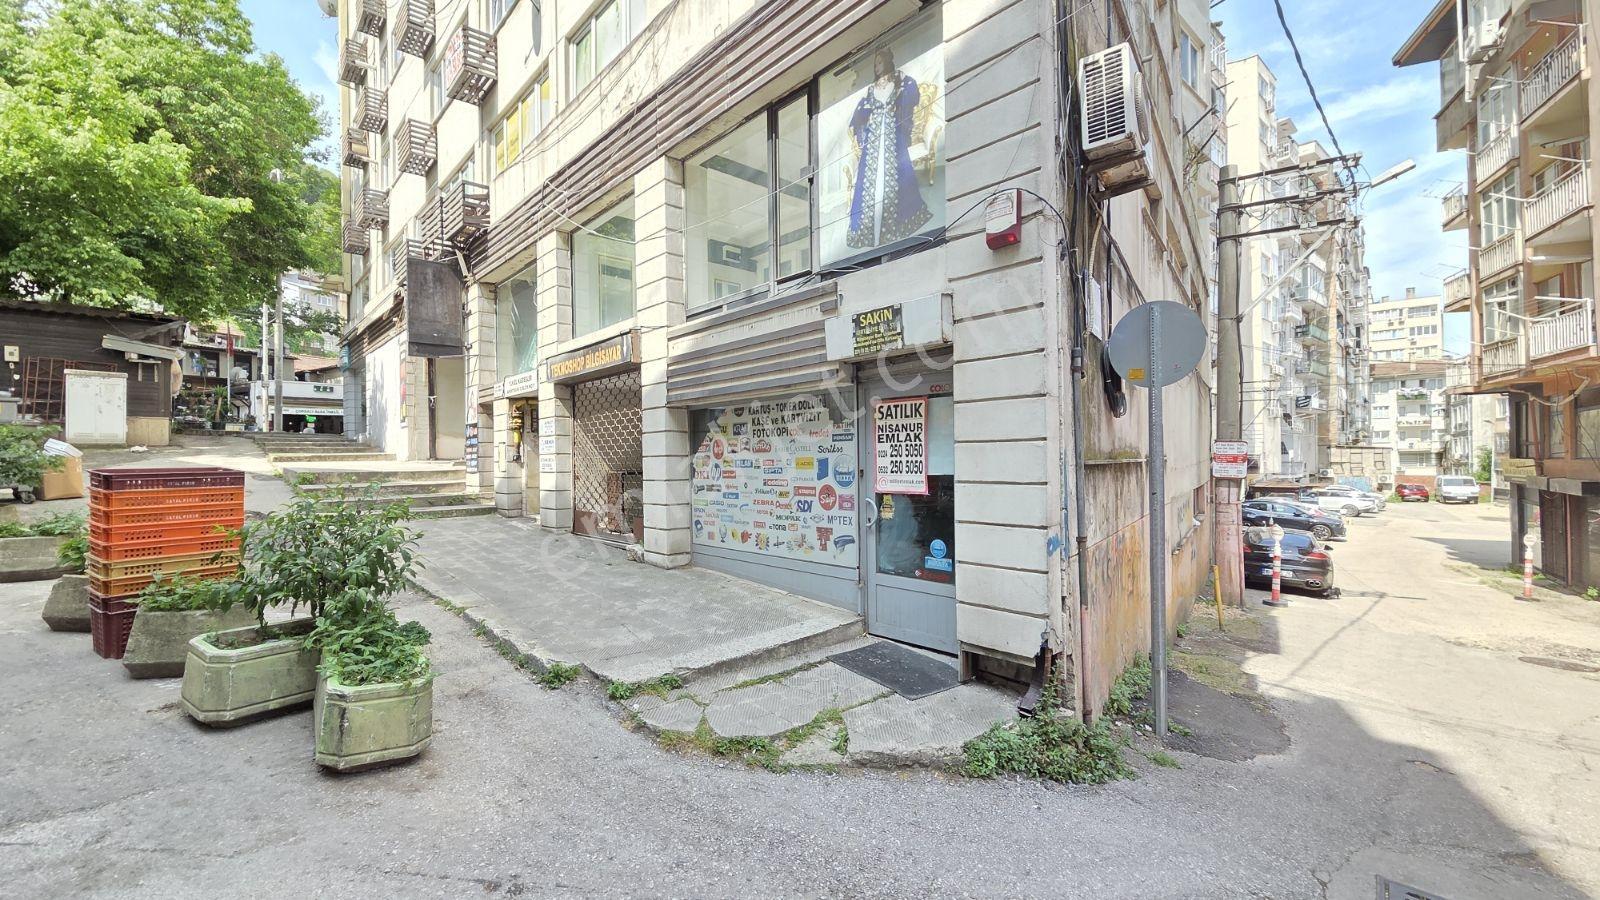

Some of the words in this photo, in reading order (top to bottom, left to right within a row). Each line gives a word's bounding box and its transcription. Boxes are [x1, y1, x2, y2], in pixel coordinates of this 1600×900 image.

[551, 357, 585, 377] TEKNOSHOP
[877, 402, 923, 420] SATILIK
[771, 415, 779, 426] ve
[877, 422, 923, 433] NİSANUR
[877, 433, 923, 444] EMLAK
[889, 444, 903, 458] 250
[904, 444, 924, 458] 5050
[890, 460, 903, 474] 250
[905, 460, 924, 474] 5050
[767, 480, 788, 488] edding
[753, 499, 775, 507] ZEBRA
